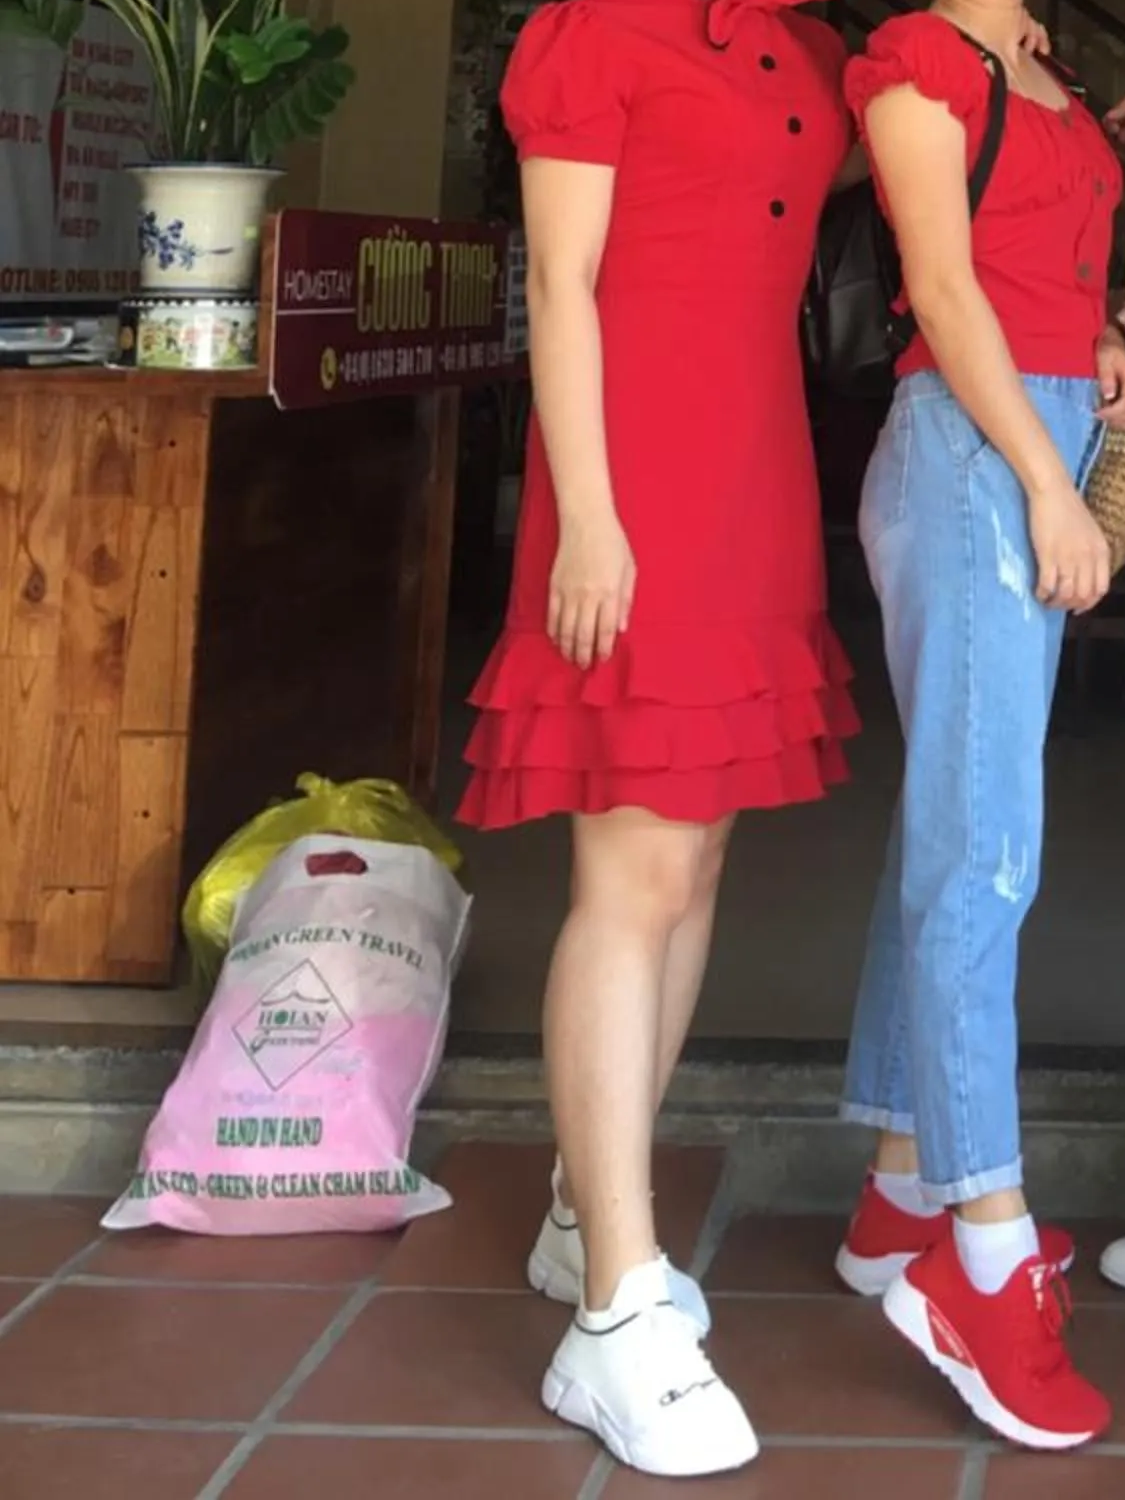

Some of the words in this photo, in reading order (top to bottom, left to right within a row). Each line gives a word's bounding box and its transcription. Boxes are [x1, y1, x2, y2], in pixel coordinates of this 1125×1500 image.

[216, 1118, 258, 1148] HAND
[279, 1118, 323, 1147] HAND
[271, 1172, 321, 1198] CLEAN
[323, 1171, 367, 1197] CHAM
